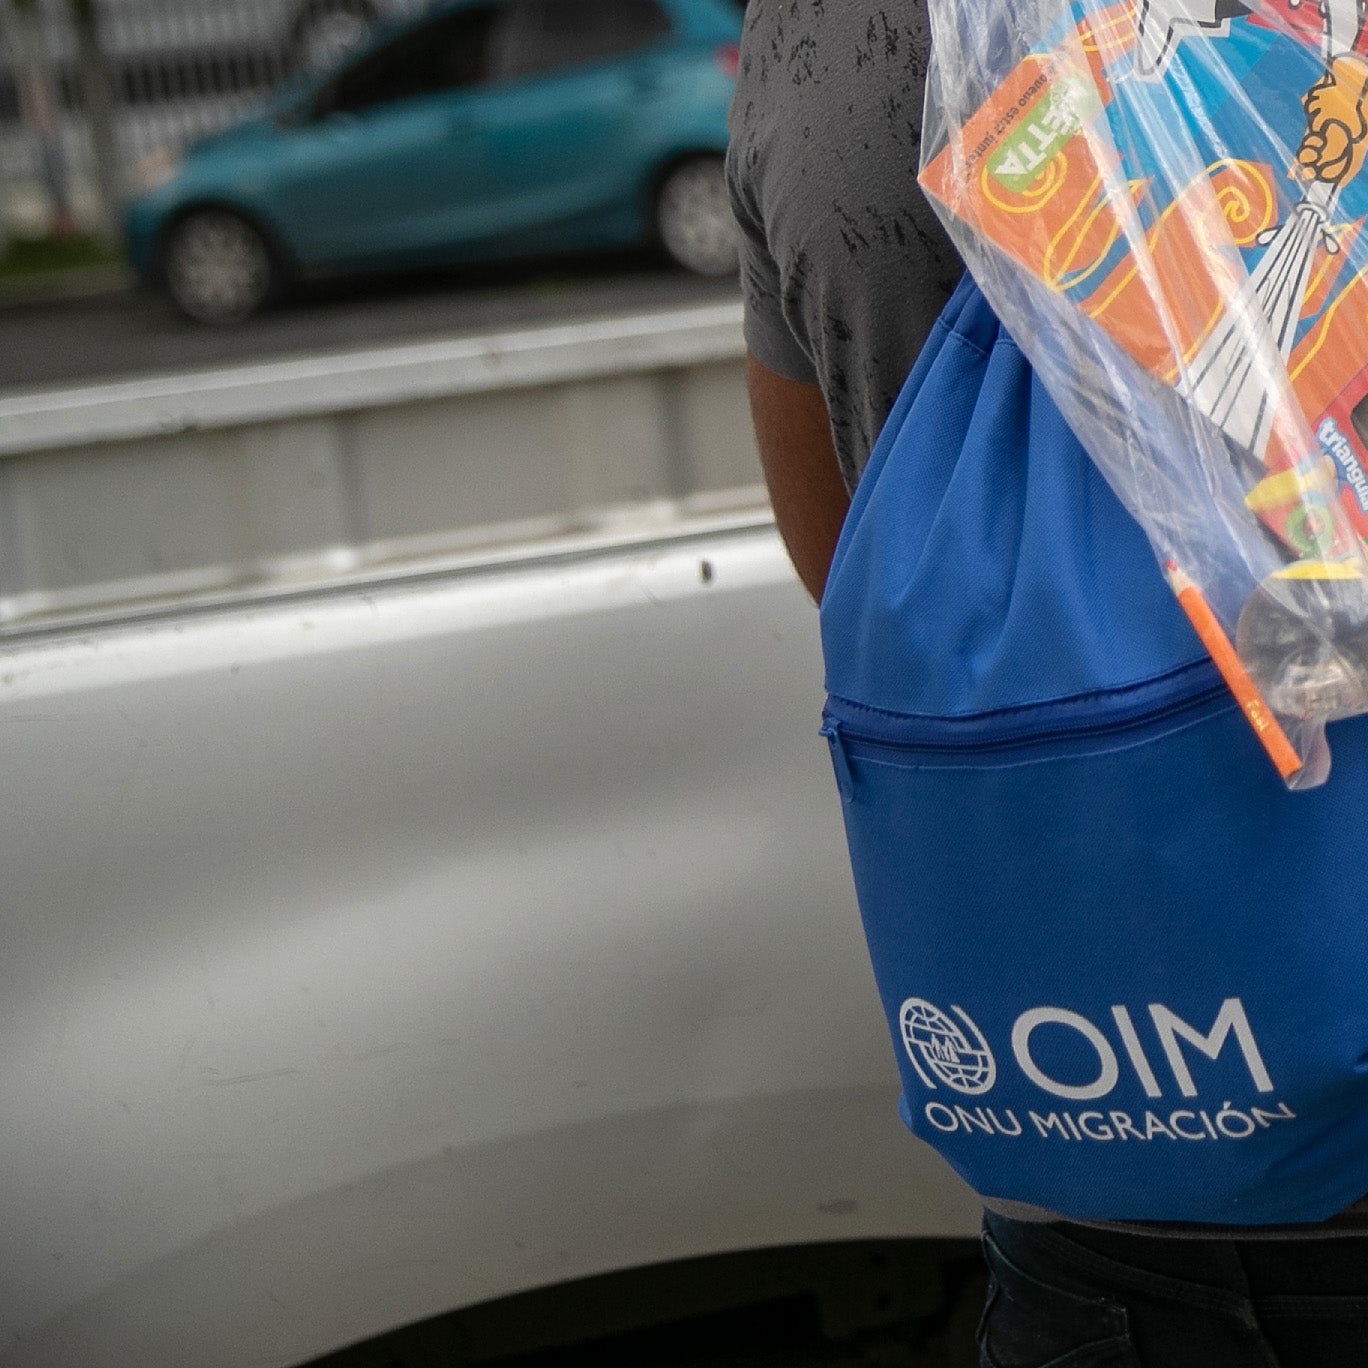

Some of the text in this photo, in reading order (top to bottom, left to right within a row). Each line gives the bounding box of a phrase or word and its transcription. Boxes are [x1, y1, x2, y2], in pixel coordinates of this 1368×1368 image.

[1010, 997, 1275, 1101] OIM
[924, 1100, 1298, 1143] ONU MIGRACIÓN
